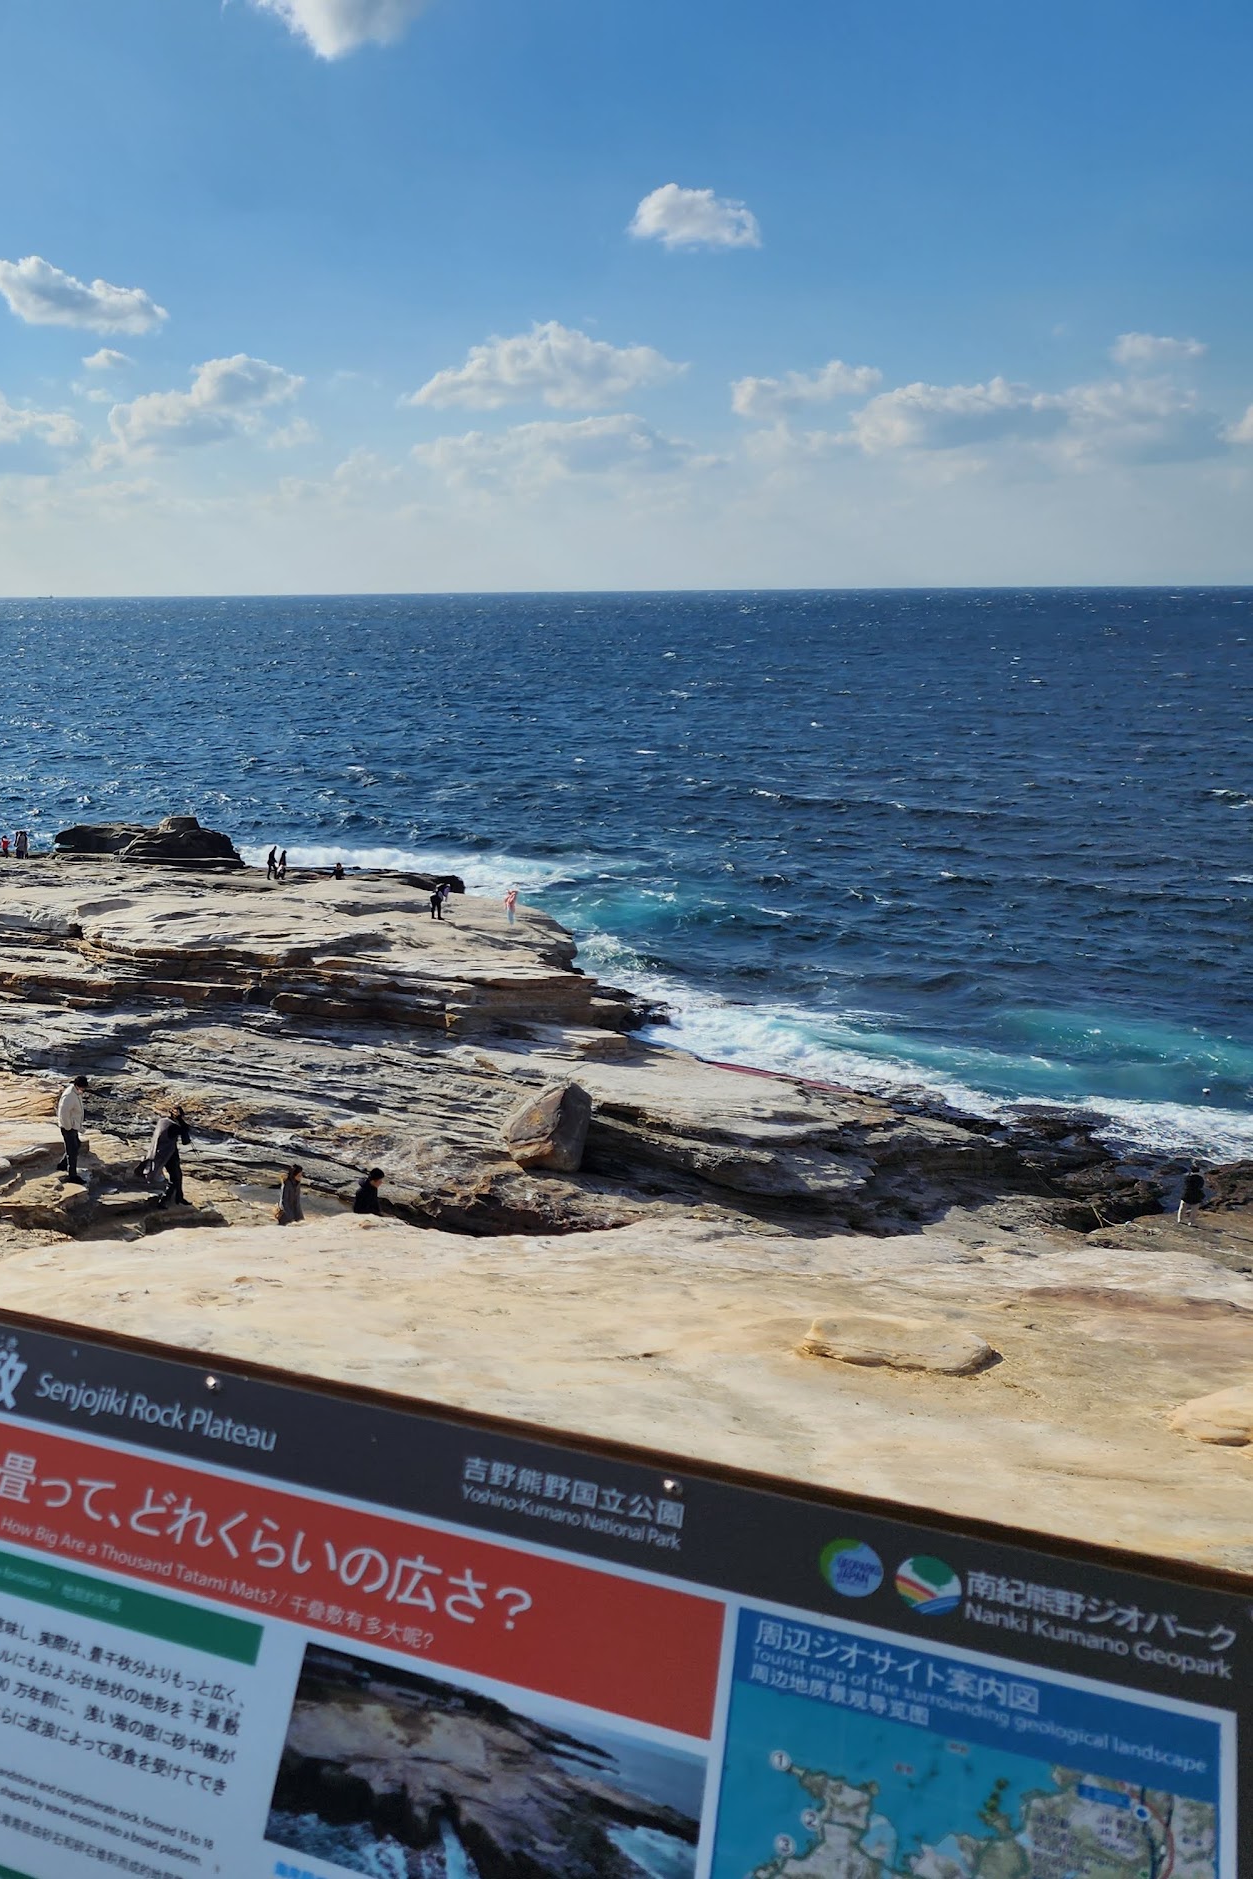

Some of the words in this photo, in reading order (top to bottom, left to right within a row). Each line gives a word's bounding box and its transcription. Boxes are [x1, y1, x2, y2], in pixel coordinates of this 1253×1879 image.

[34, 1371, 129, 1416] Senjojiki
[129, 1393, 186, 1432] Rock
[188, 1410, 278, 1452] Plateau
[461, 1484, 582, 1527] Yoshino-Kumano
[582, 1513, 646, 1543] National
[647, 1529, 682, 1551] Park
[463, 1457, 686, 1530] 吉野熊野国立公園
[0, 1517, 33, 1538] How
[34, 1526, 58, 1548] Big
[60, 1533, 86, 1553] Are
[87, 1543, 97, 1556] a
[100, 1544, 172, 1577] Thousand
[176, 1563, 228, 1592] Tatami
[964, 1602, 1028, 1632] Nanki
[1031, 1618, 1129, 1657] Kumano
[1133, 1643, 1233, 1679] Geopark
[965, 1571, 1237, 1652] 南紀熊野ジオパーク
[755, 1619, 1039, 1714] 周辺ジオサイト案内図
[753, 1645, 806, 1673] Tourist
[809, 1661, 847, 1685] map
[850, 1671, 869, 1687] of
[871, 1677, 900, 1694] the
[902, 1688, 1010, 1728] surrounding
[1014, 1713, 1109, 1749] geological
[1112, 1736, 1208, 1774] landscape
[32, 1797, 44, 1811] by
[103, 1821, 123, 1837] into
[131, 1831, 160, 1851] broad
[38, 1781, 57, 1795] and
[142, 1816, 177, 1839] formed
[178, 1829, 189, 1843] 15
[190, 1833, 201, 1847] to
